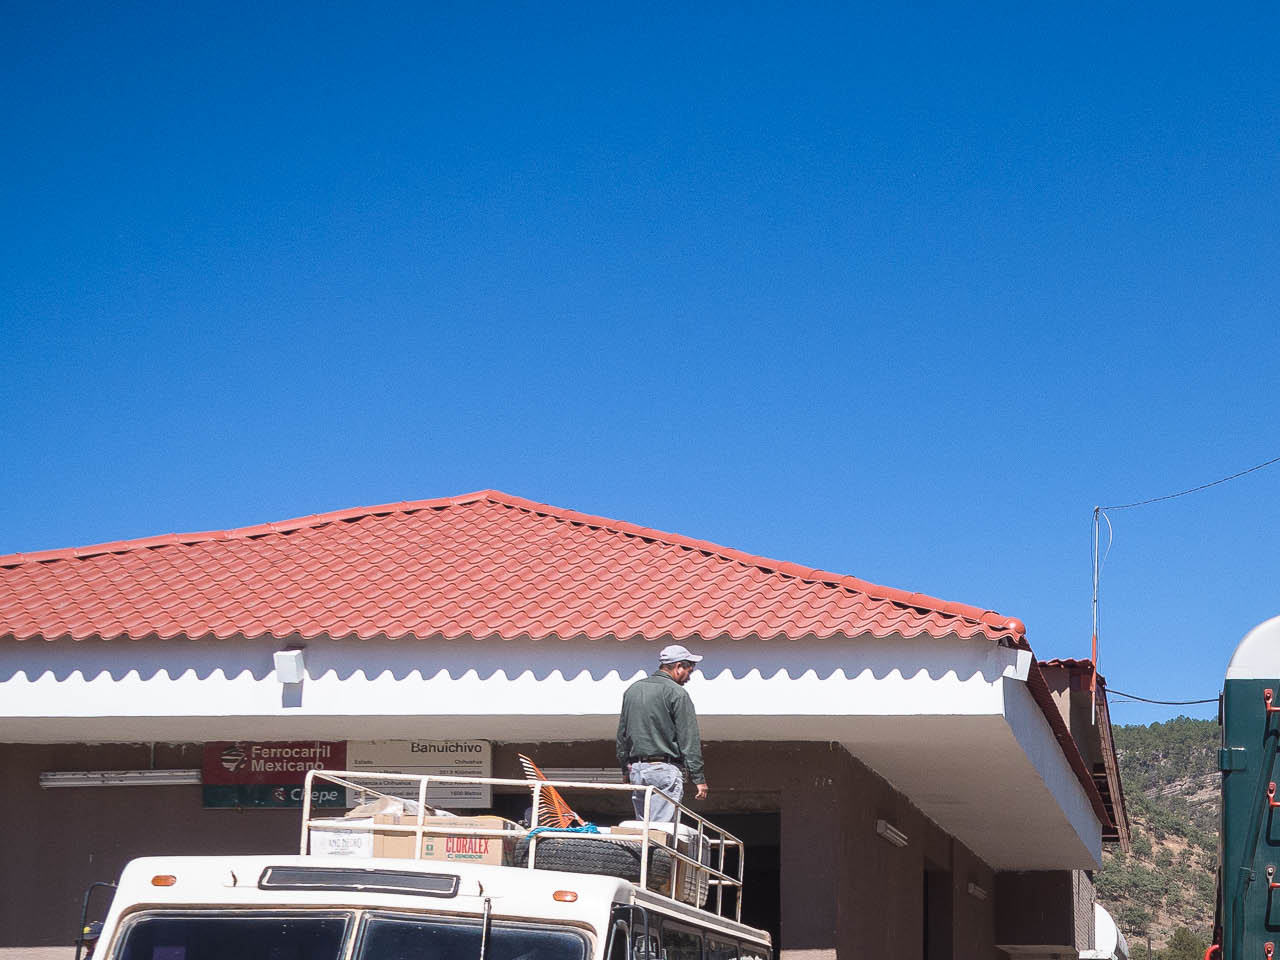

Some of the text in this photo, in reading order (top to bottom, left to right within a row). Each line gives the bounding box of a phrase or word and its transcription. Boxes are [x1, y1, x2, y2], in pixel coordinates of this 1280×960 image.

[251, 745, 331, 758] Ferrocarril
[411, 742, 482, 753] Bahuichivo
[251, 760, 325, 772] Mexicano
[445, 836, 489, 854] CLORALEX
